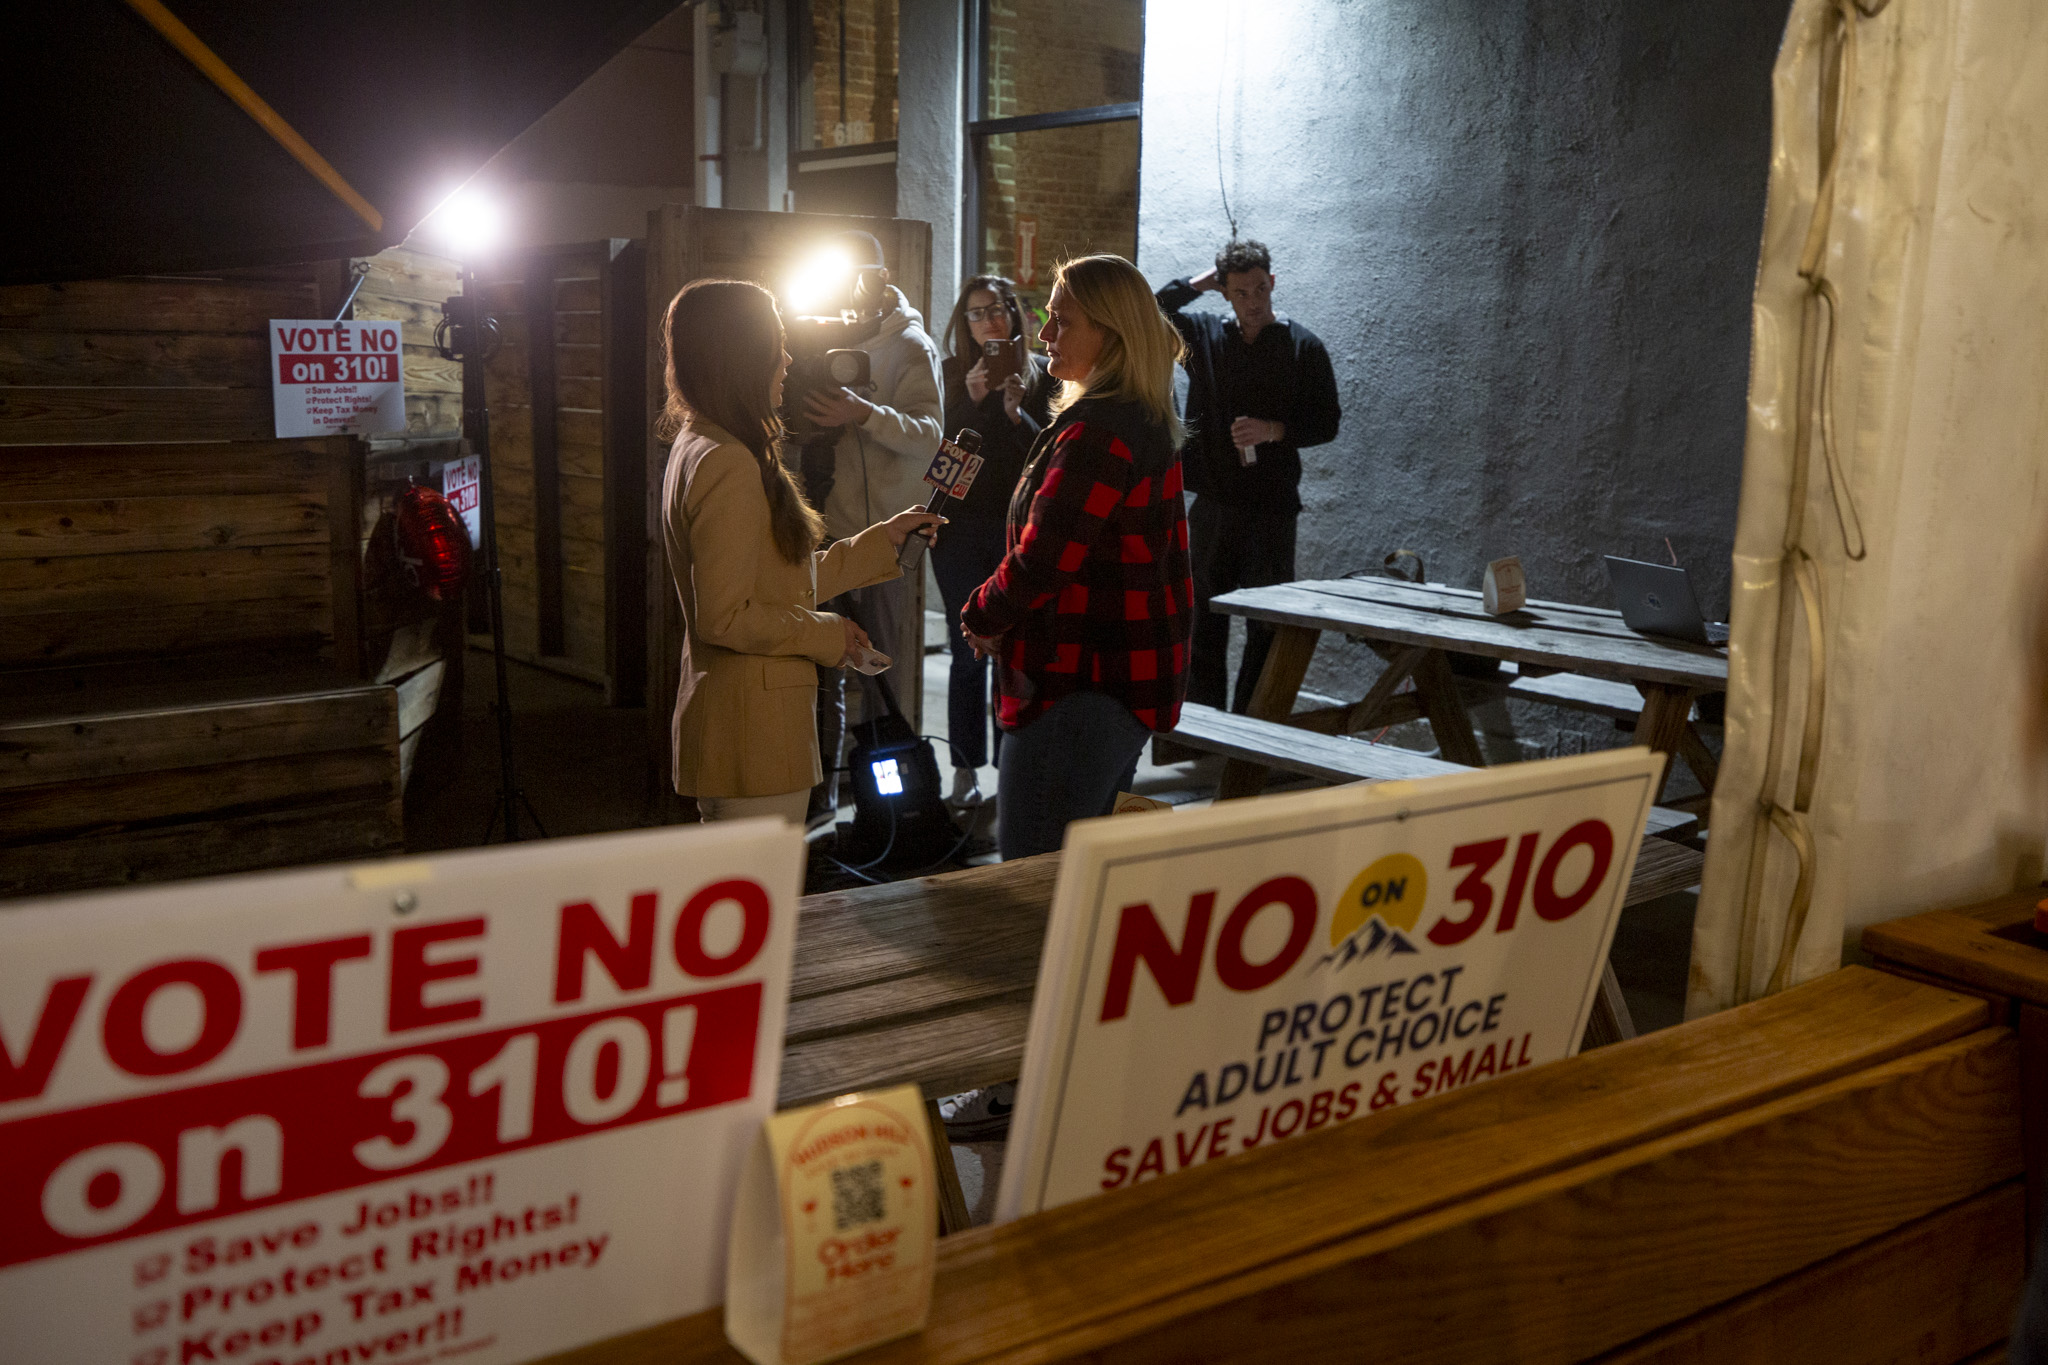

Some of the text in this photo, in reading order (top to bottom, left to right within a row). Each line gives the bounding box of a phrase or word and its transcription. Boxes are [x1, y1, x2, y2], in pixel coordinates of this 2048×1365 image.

[278, 328, 397, 352] VOTE NO
[292, 356, 387, 381] on 310!
[312, 386, 331, 394] Save
[312, 395, 372, 405] Protect Rights!
[312, 405, 377, 415] Keep Tax Money
[446, 461, 477, 490] VOTE NO
[931, 456, 960, 486] 31
[943, 441, 968, 463] FOX
[460, 485, 476, 511] 310!
[1100, 819, 1614, 1024] NO ON 310
[0, 877, 772, 1101] VOTE NO
[1257, 966, 1463, 1052] PROTECT
[1175, 993, 1507, 1118] ADULT CHOICE
[41, 1004, 699, 1240] on 310!
[1100, 1033, 1532, 1190] SAVE JOBS & SMALL
[183, 1172, 495, 1275] Save Jobs!!
[180, 1192, 581, 1323] Protect Rights!
[180, 1310, 323, 1365] Keep
[344, 1279, 435, 1321] Tax
[456, 1234, 610, 1294] Money
